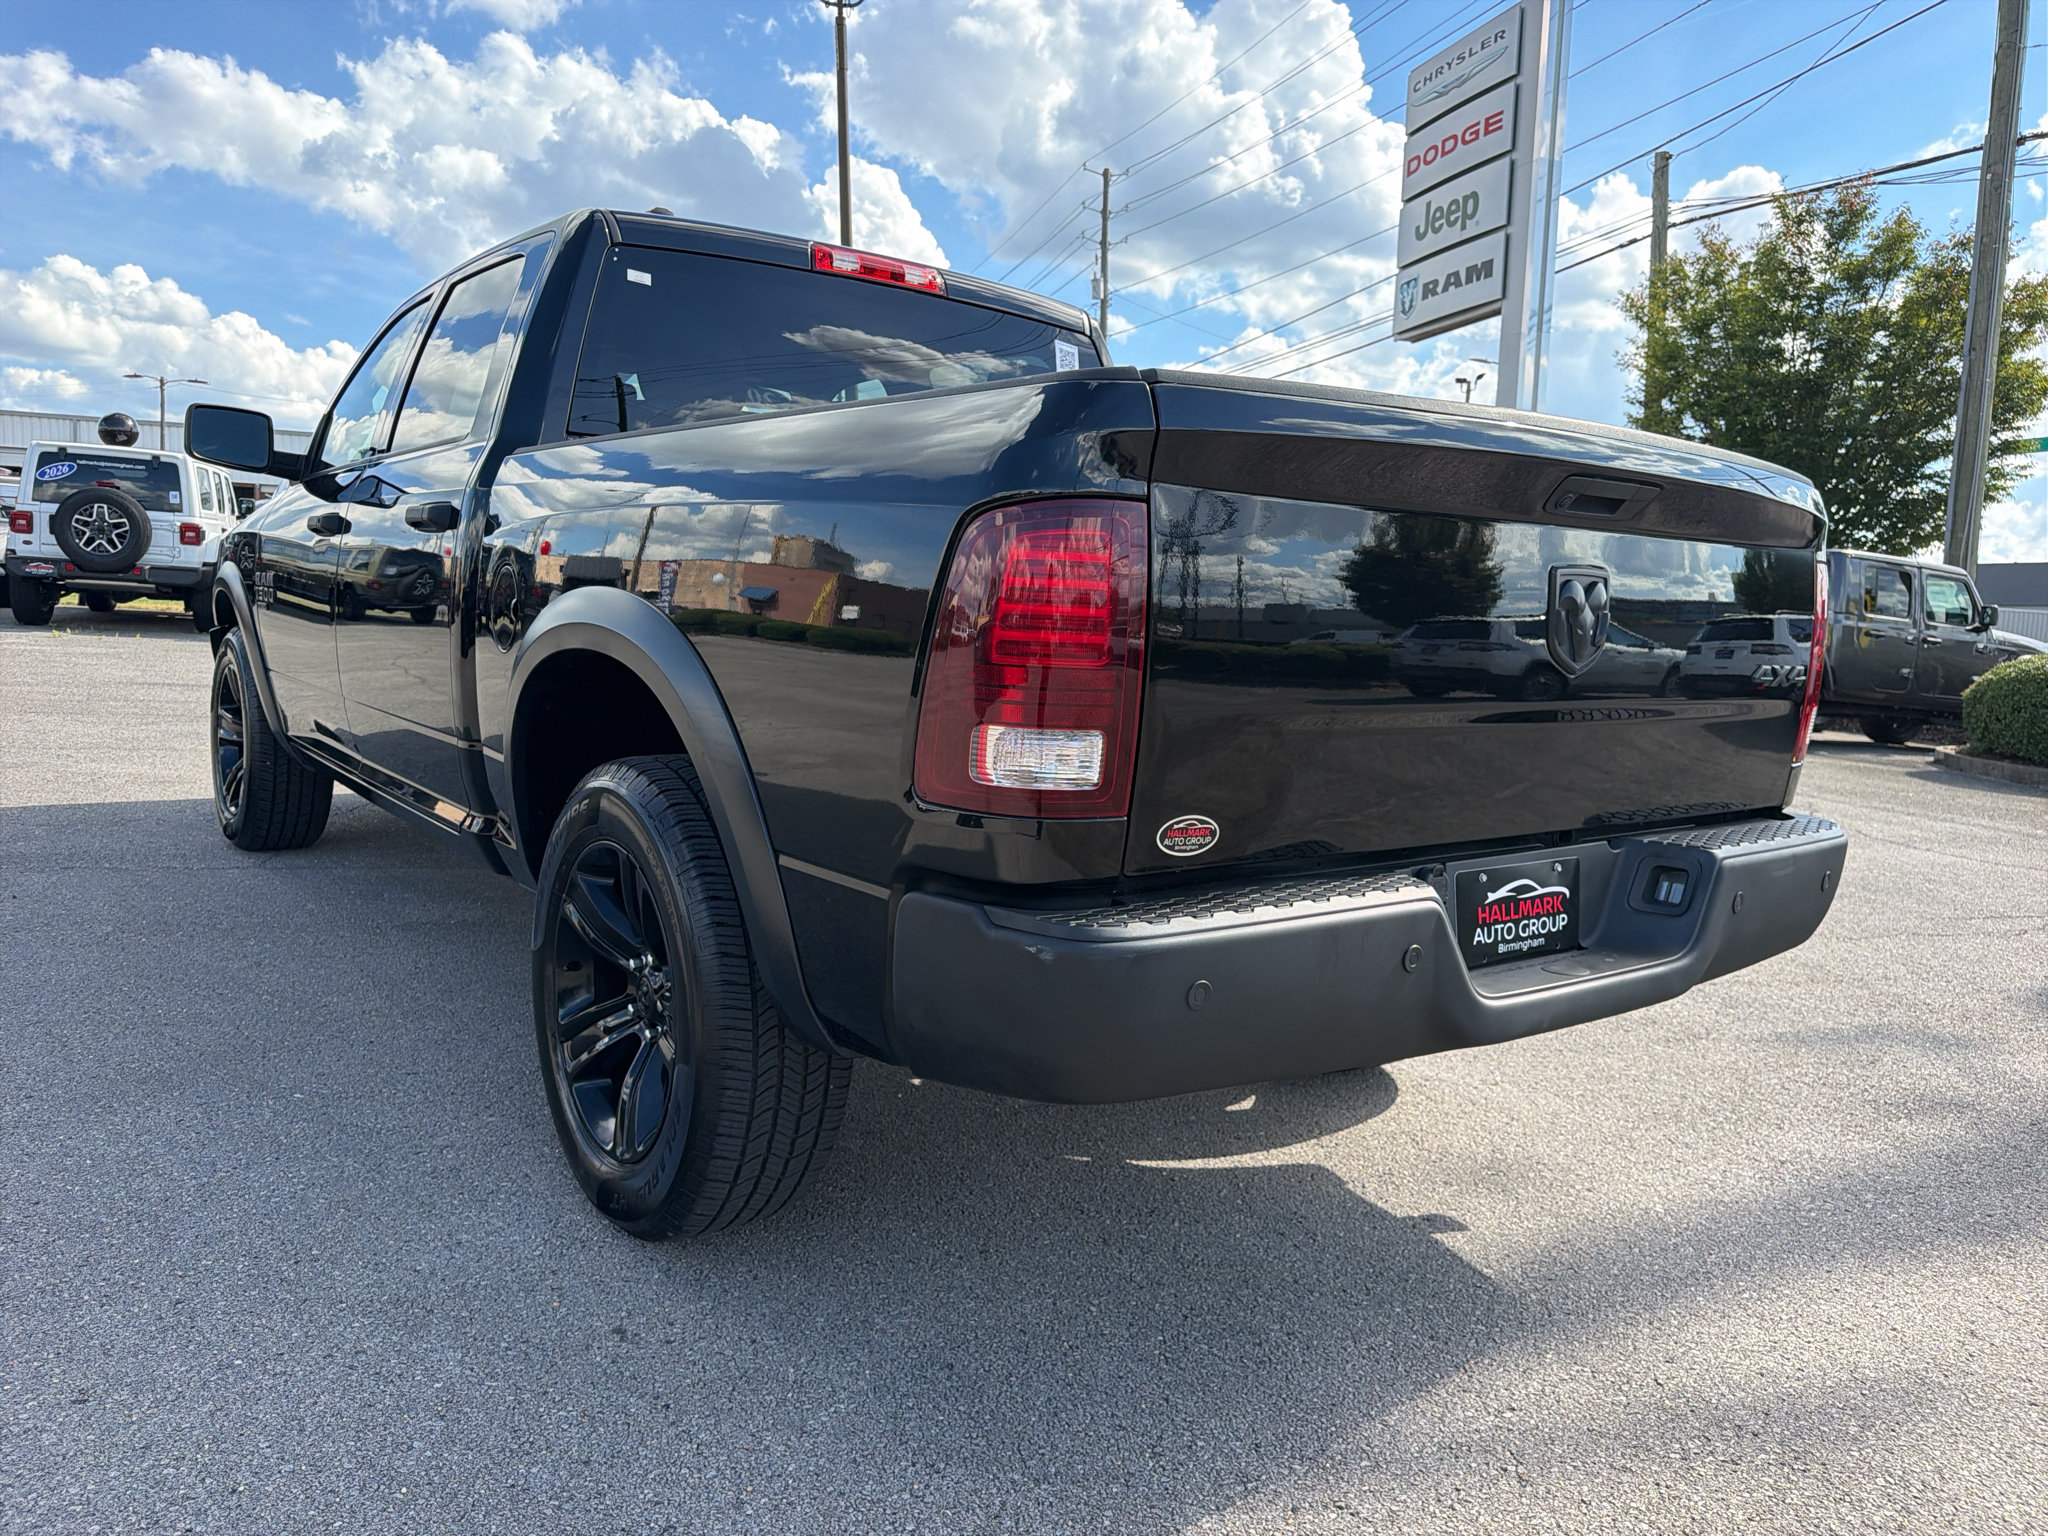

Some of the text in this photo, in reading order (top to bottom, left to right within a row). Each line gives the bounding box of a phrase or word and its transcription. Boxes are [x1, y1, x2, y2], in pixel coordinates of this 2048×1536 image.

[1412, 29, 1507, 94] CHRYSLER
[1406, 110, 1504, 177] DODGE
[1415, 190, 1479, 241] Jeep
[1422, 258, 1494, 301] RAM
[44, 464, 70, 479] 2026
[1163, 837, 1211, 846] AUTO GROUP
[1166, 828, 1211, 837] HALLMARK
[1477, 894, 1564, 925] HALLMARK
[1473, 914, 1568, 945] AUTO GROUP
[1498, 937, 1545, 953] Birmingham
